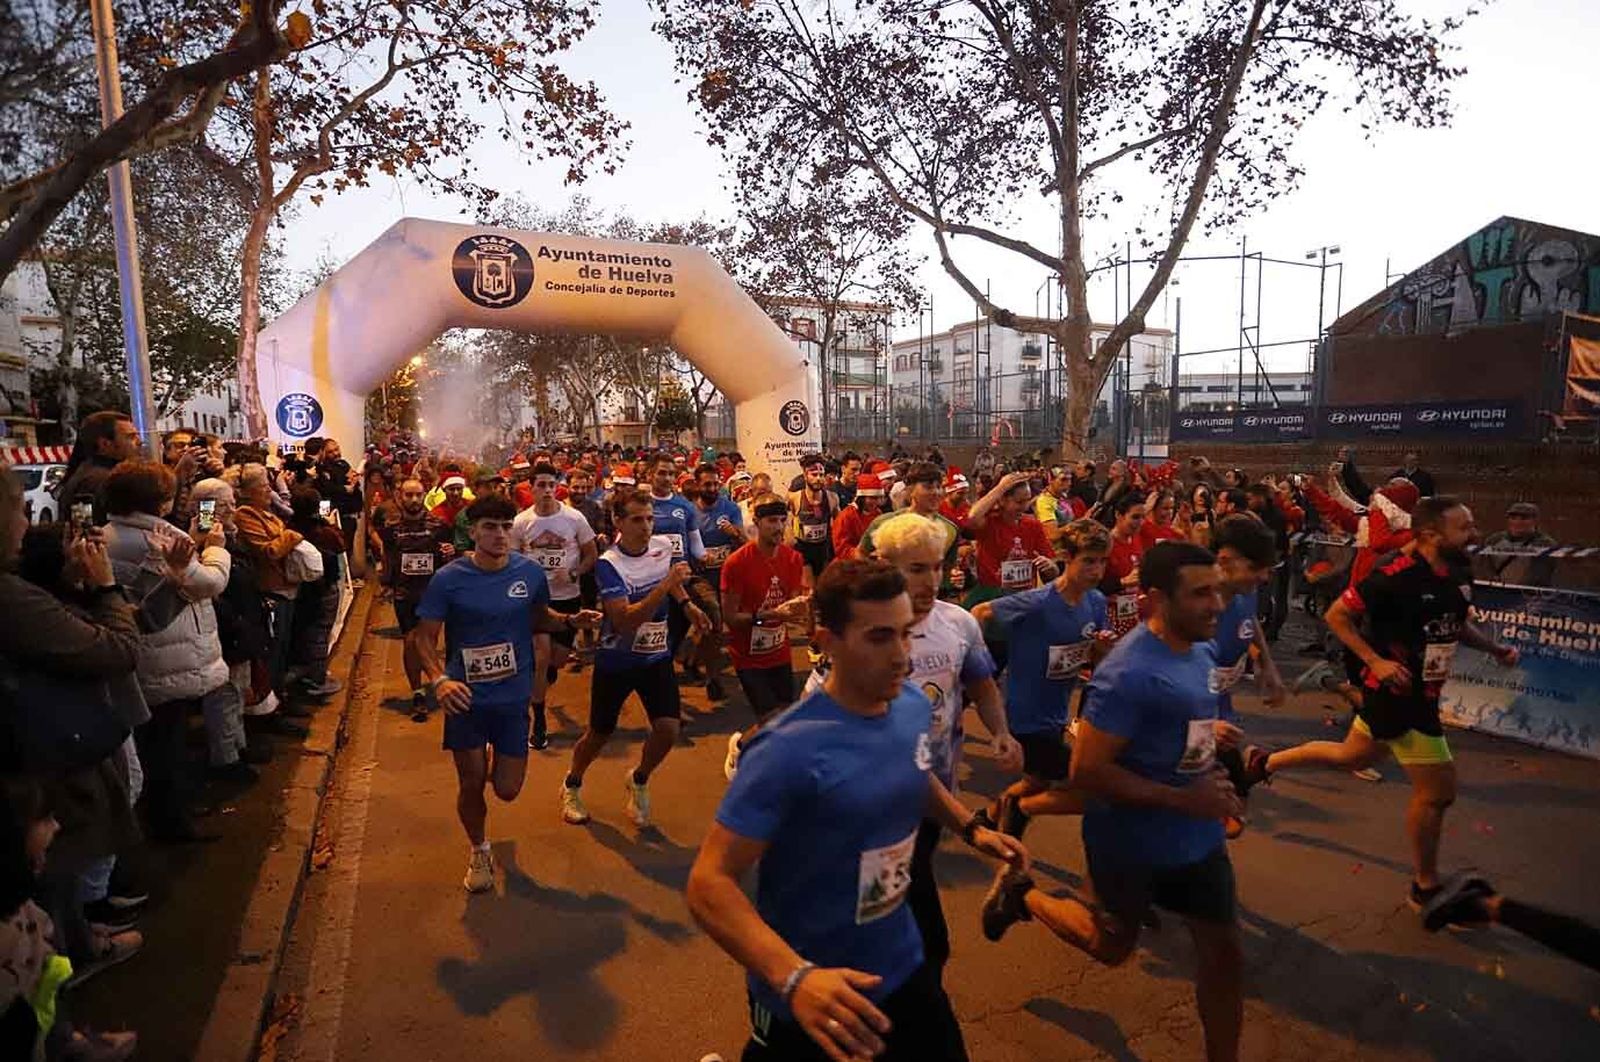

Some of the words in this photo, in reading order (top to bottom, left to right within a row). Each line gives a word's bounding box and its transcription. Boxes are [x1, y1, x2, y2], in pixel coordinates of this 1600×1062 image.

[537, 245, 672, 268] Ayuntamiento
[578, 264, 602, 280] de
[608, 265, 673, 284] Huelva
[609, 284, 623, 295] de
[626, 286, 676, 298] Deportes
[1261, 415, 1304, 425] HYUNDAI
[1348, 412, 1402, 422] HYUNDAI
[1441, 408, 1506, 420] HYUNDAI
[1196, 418, 1233, 428] HYUNDAI
[417, 560, 428, 569] 54
[549, 556, 561, 566] 82
[1502, 625, 1530, 641] de
[1538, 629, 1600, 652] Huel
[484, 654, 511, 671] 548
